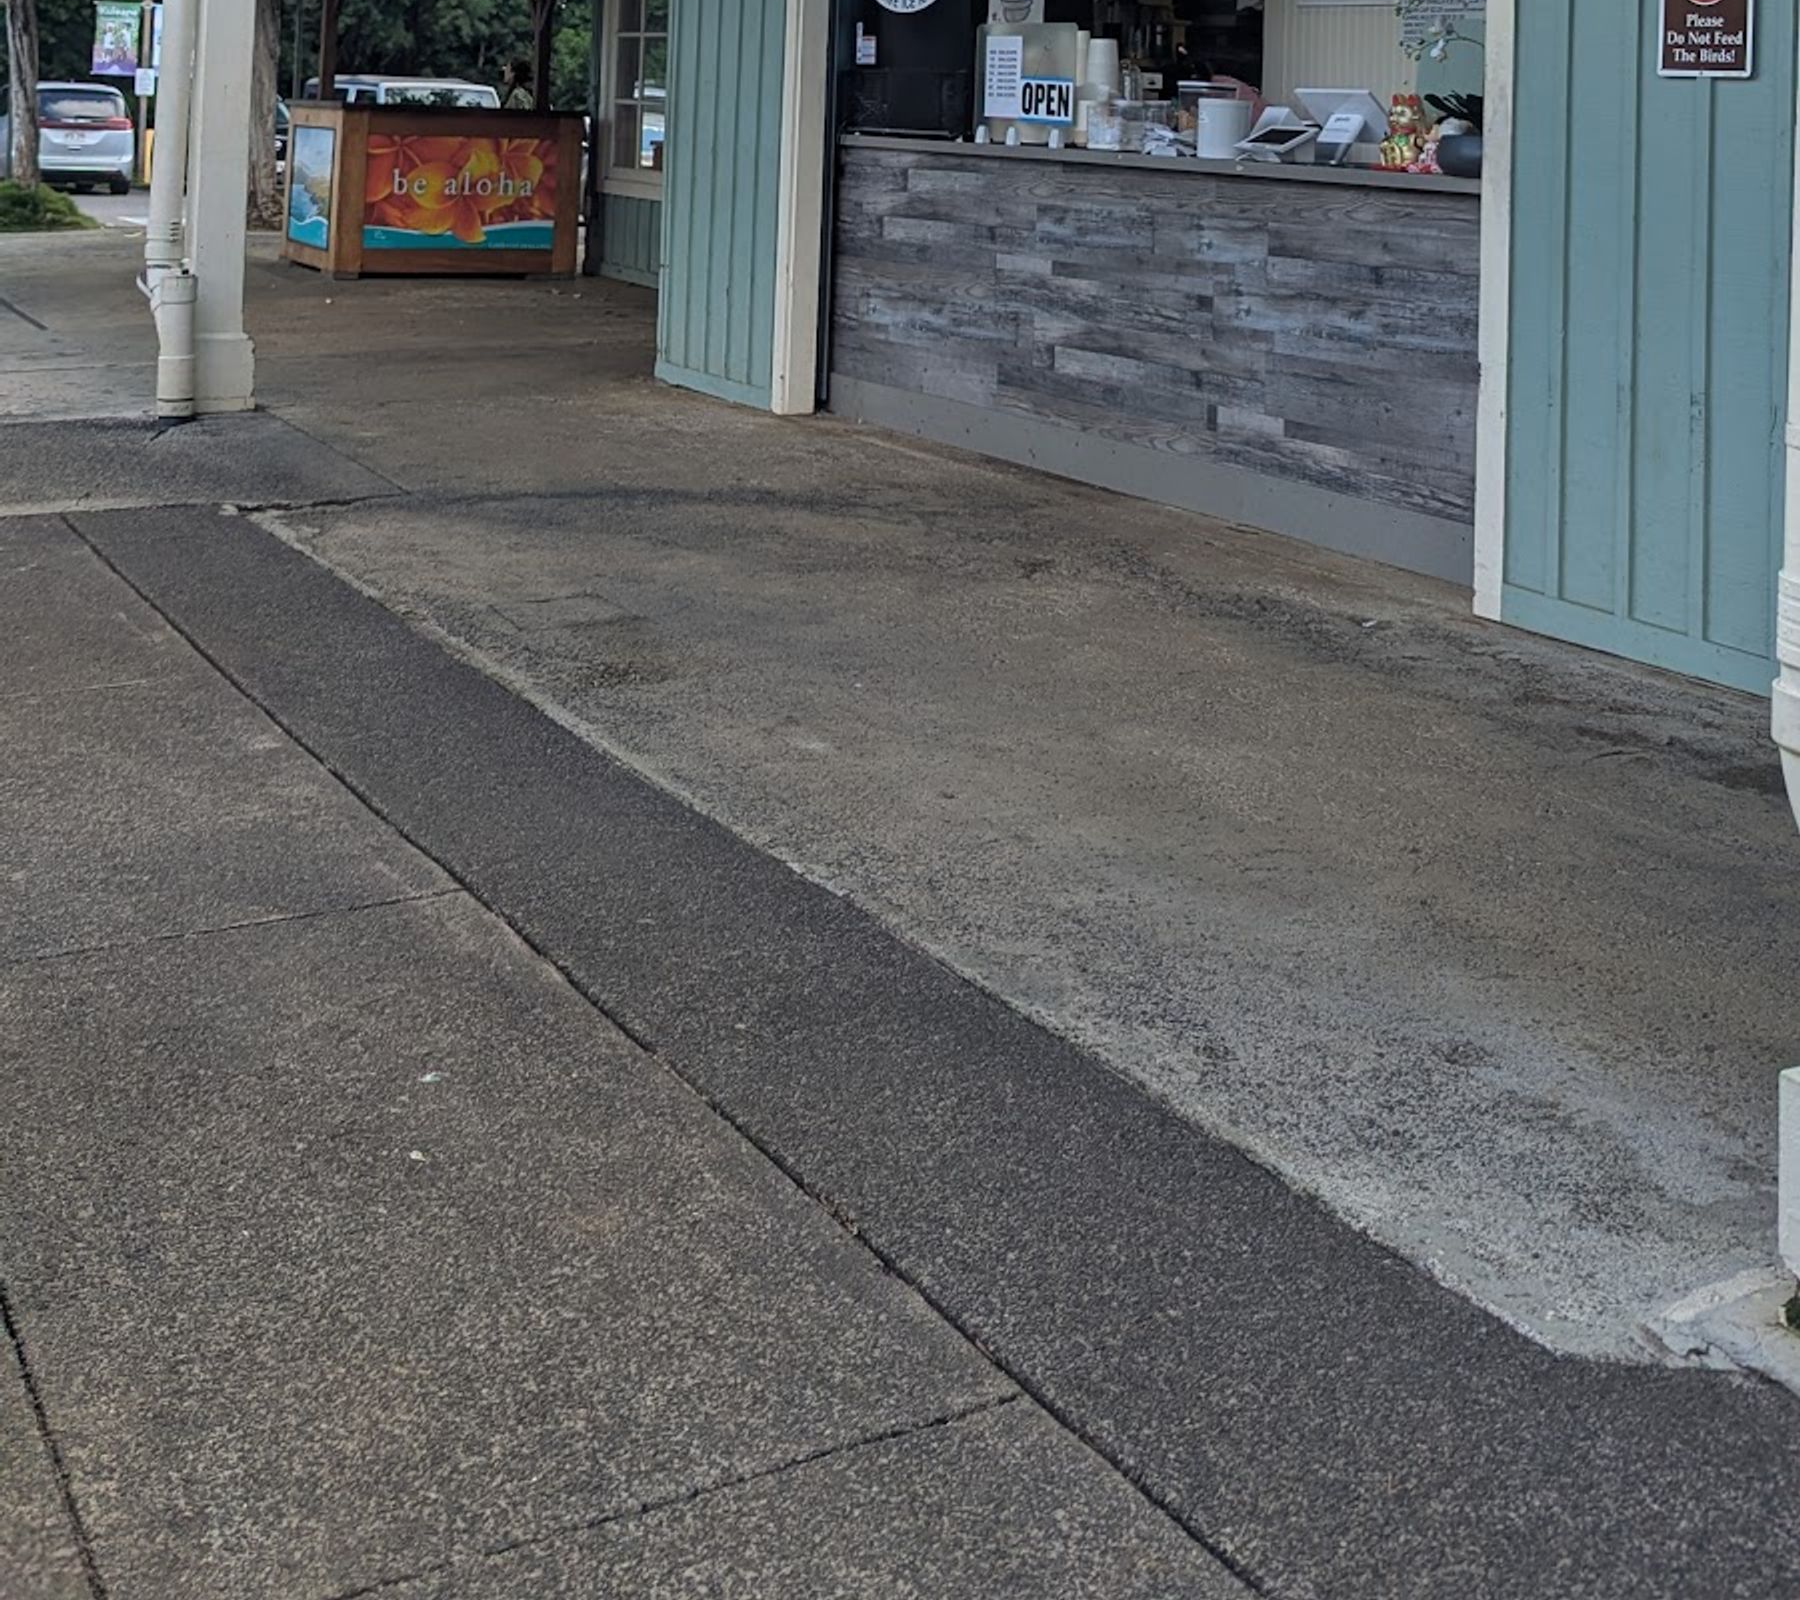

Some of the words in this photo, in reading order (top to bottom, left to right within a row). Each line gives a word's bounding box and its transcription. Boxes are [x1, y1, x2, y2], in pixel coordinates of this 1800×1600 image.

[1686, 13, 1724, 28] Please
[1667, 31, 1685, 45] Do
[1688, 31, 1711, 45] Not
[1713, 30, 1743, 45] Feed
[1672, 48, 1697, 63] The
[1699, 48, 1735, 63] Birds!
[1021, 82, 1070, 117] OPEN
[393, 168, 427, 196] be
[444, 172, 533, 197] aloha
